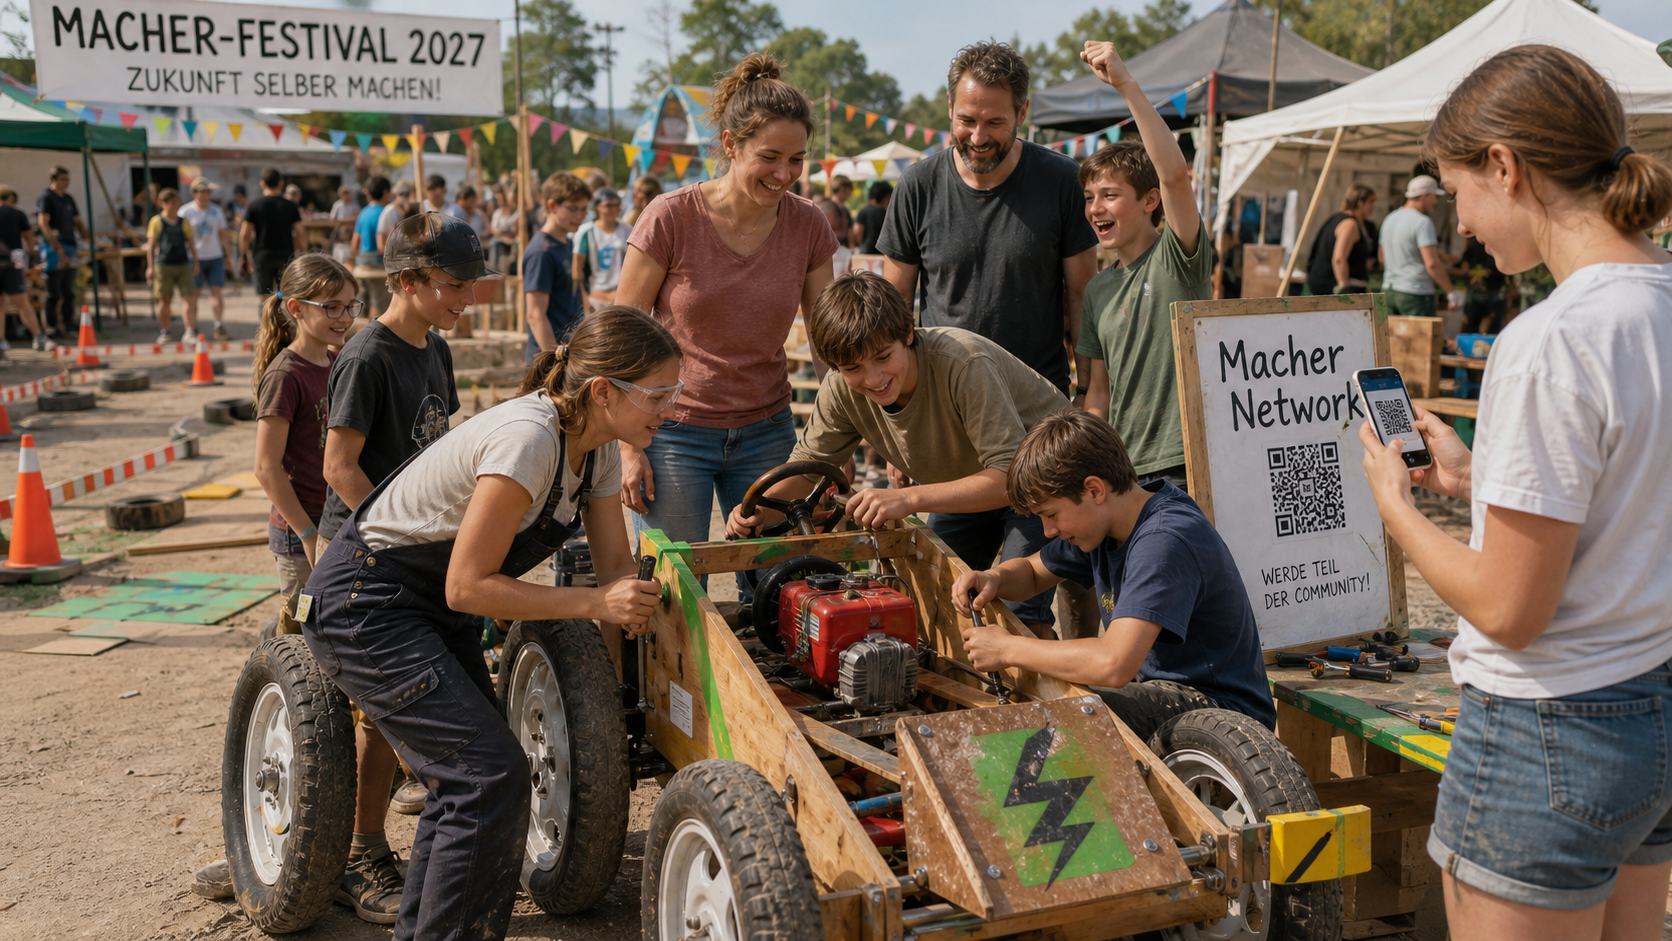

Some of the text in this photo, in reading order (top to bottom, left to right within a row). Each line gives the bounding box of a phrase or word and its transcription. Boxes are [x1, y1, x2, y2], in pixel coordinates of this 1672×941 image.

[52, 5, 485, 67] MACHER-FESTIVAL 2027
[127, 66, 441, 101] ZUKUNFT SELBER MACHEN!
[1218, 334, 1345, 383] Macher
[1230, 380, 1365, 432] Network
[1261, 559, 1341, 587] WERDE TEIL
[1264, 590, 1290, 610] DER
